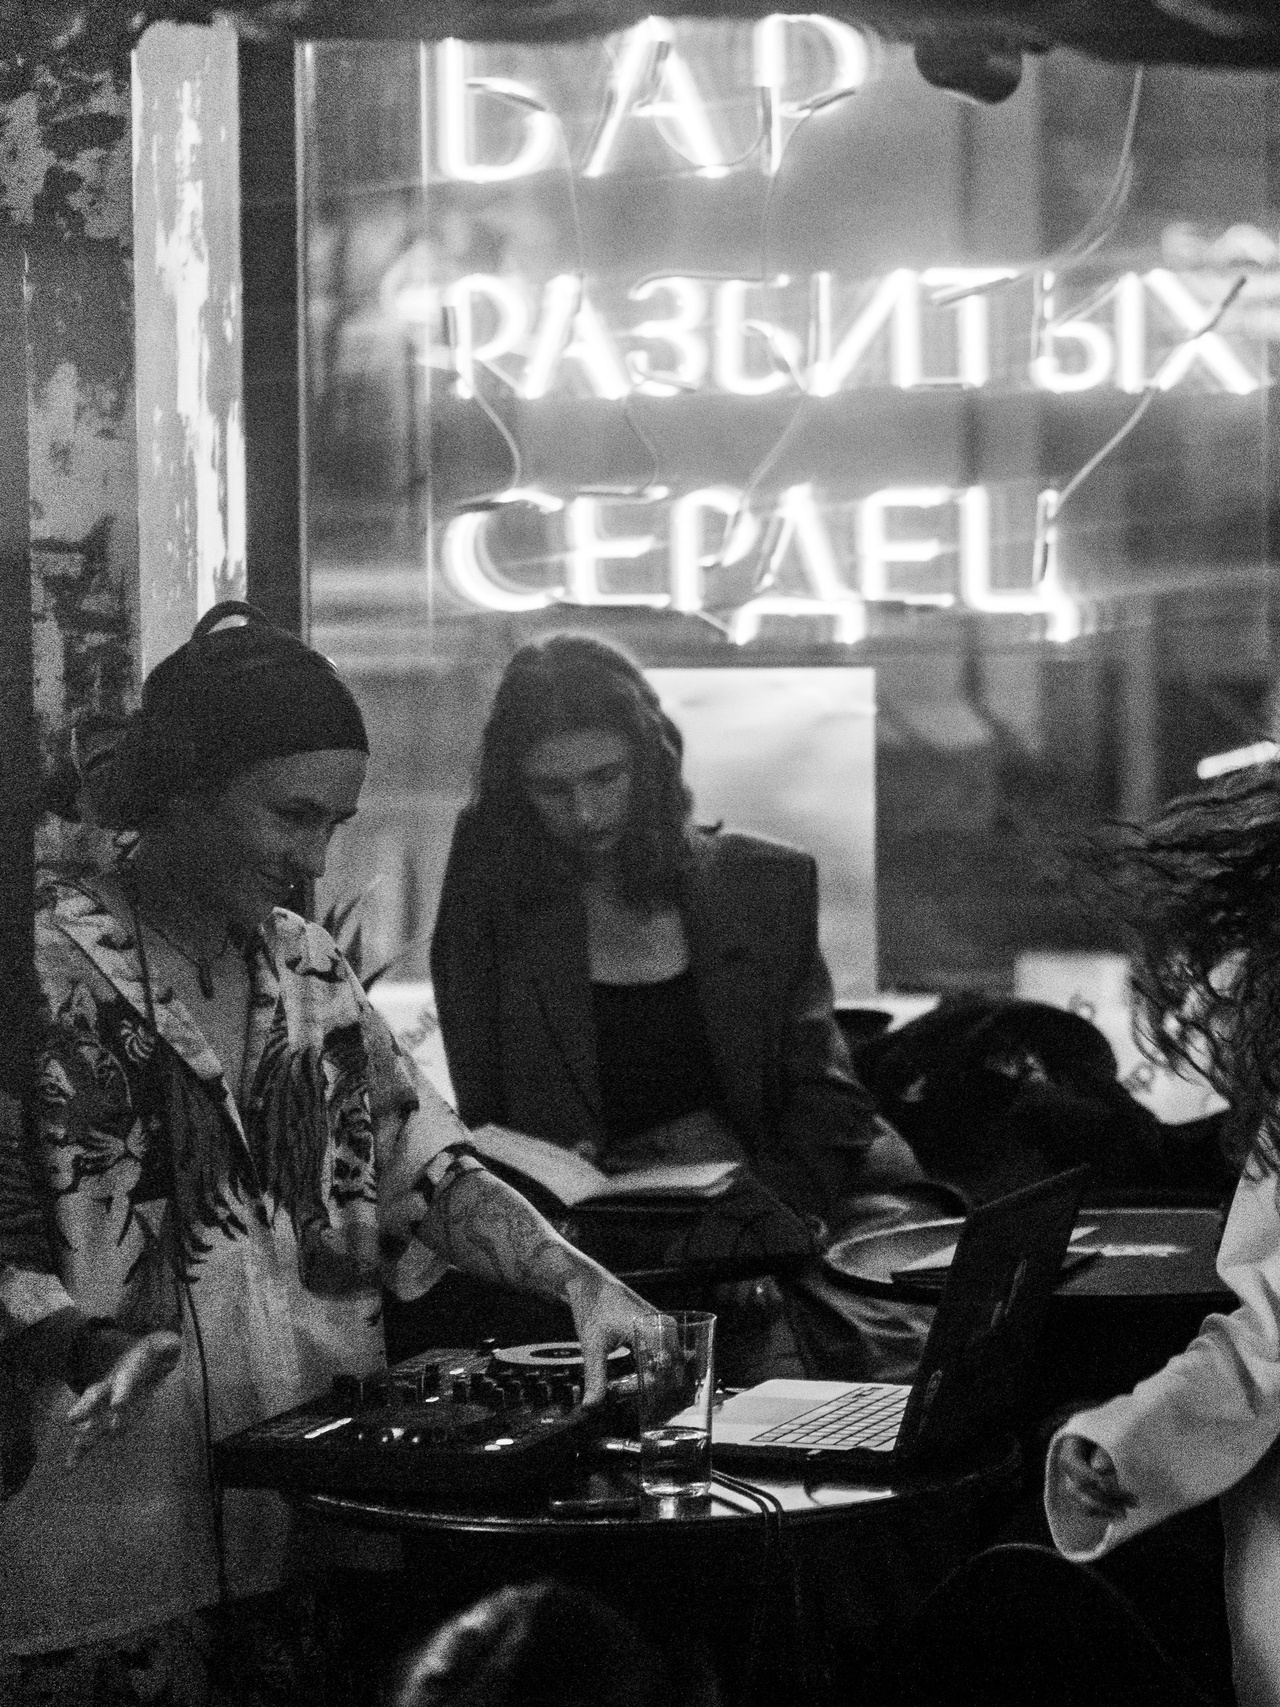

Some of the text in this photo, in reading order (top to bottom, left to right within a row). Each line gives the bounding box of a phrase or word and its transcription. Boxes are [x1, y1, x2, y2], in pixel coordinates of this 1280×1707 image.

[437, 14, 866, 182] БАР
[445, 269, 1258, 398] РАЗБИТЫХ
[443, 484, 1076, 643] СЕРДЕЦ
